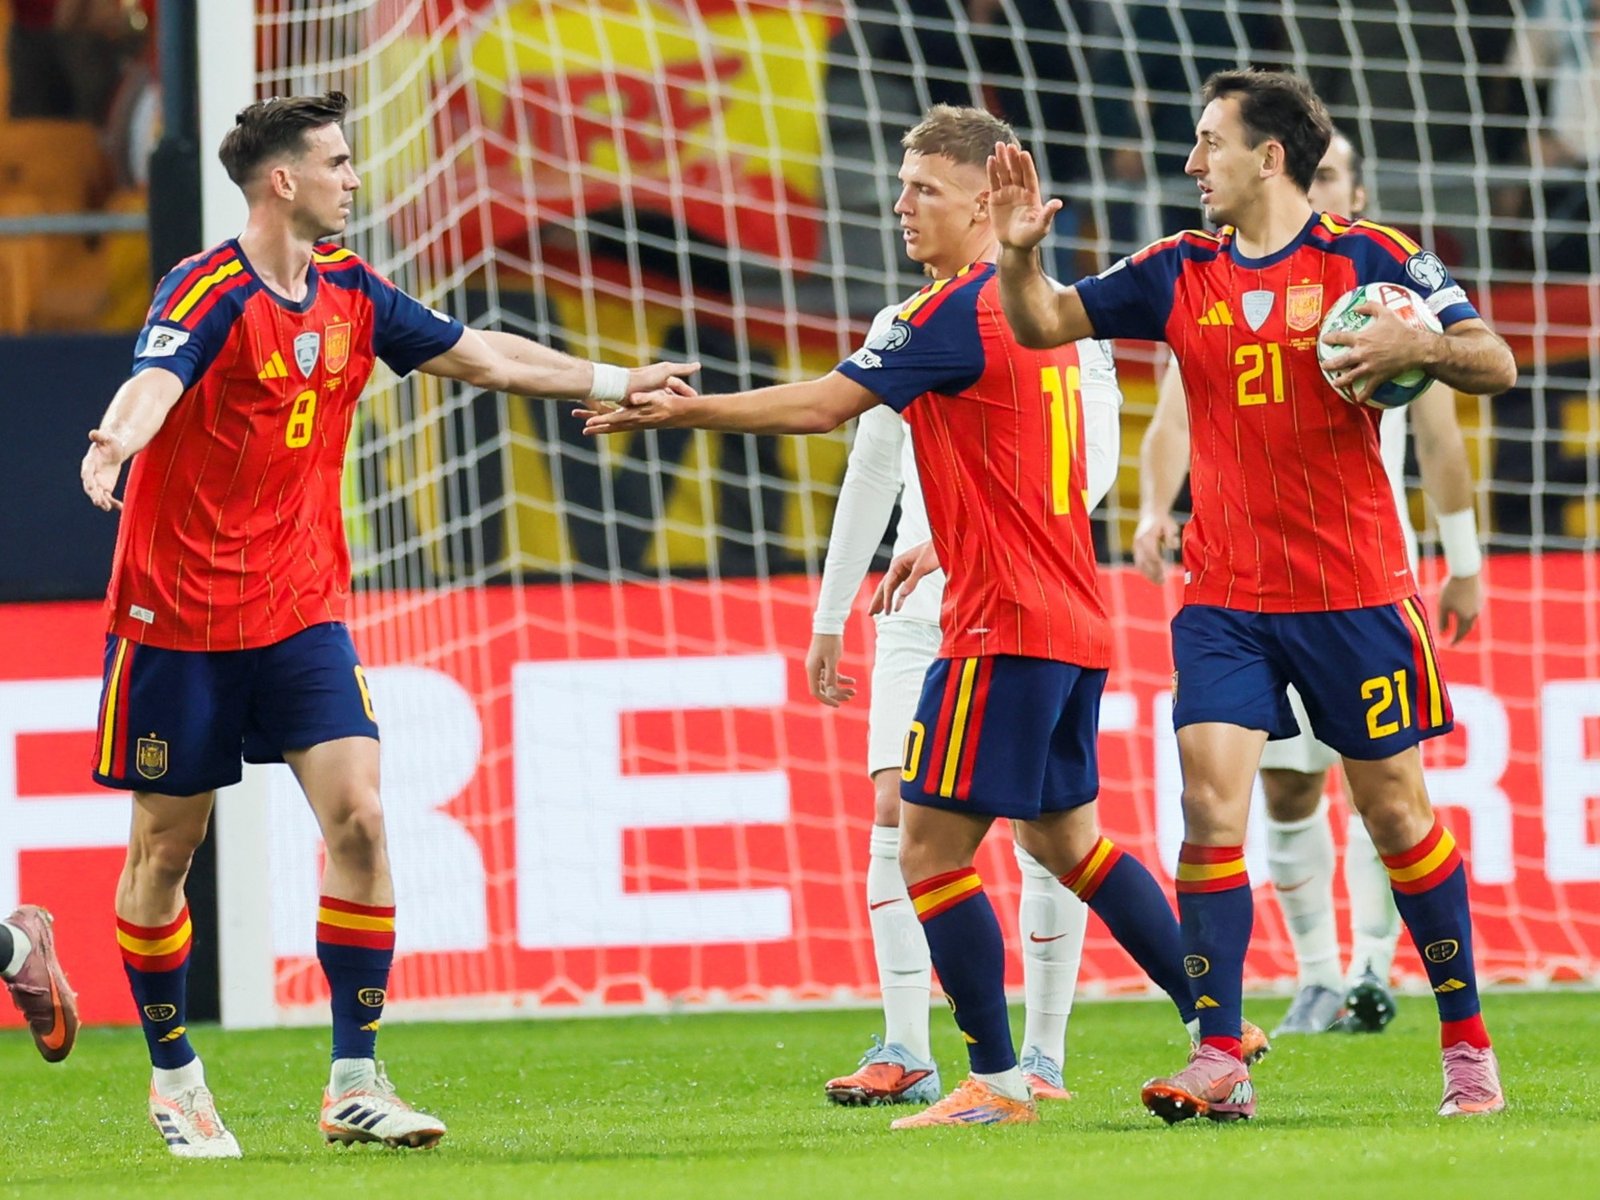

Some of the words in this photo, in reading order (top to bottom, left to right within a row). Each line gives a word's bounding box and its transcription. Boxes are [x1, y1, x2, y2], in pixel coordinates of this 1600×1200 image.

[1235, 342, 1285, 406] 21
[285, 389, 317, 448] 8
[1361, 669, 1410, 739] 21
